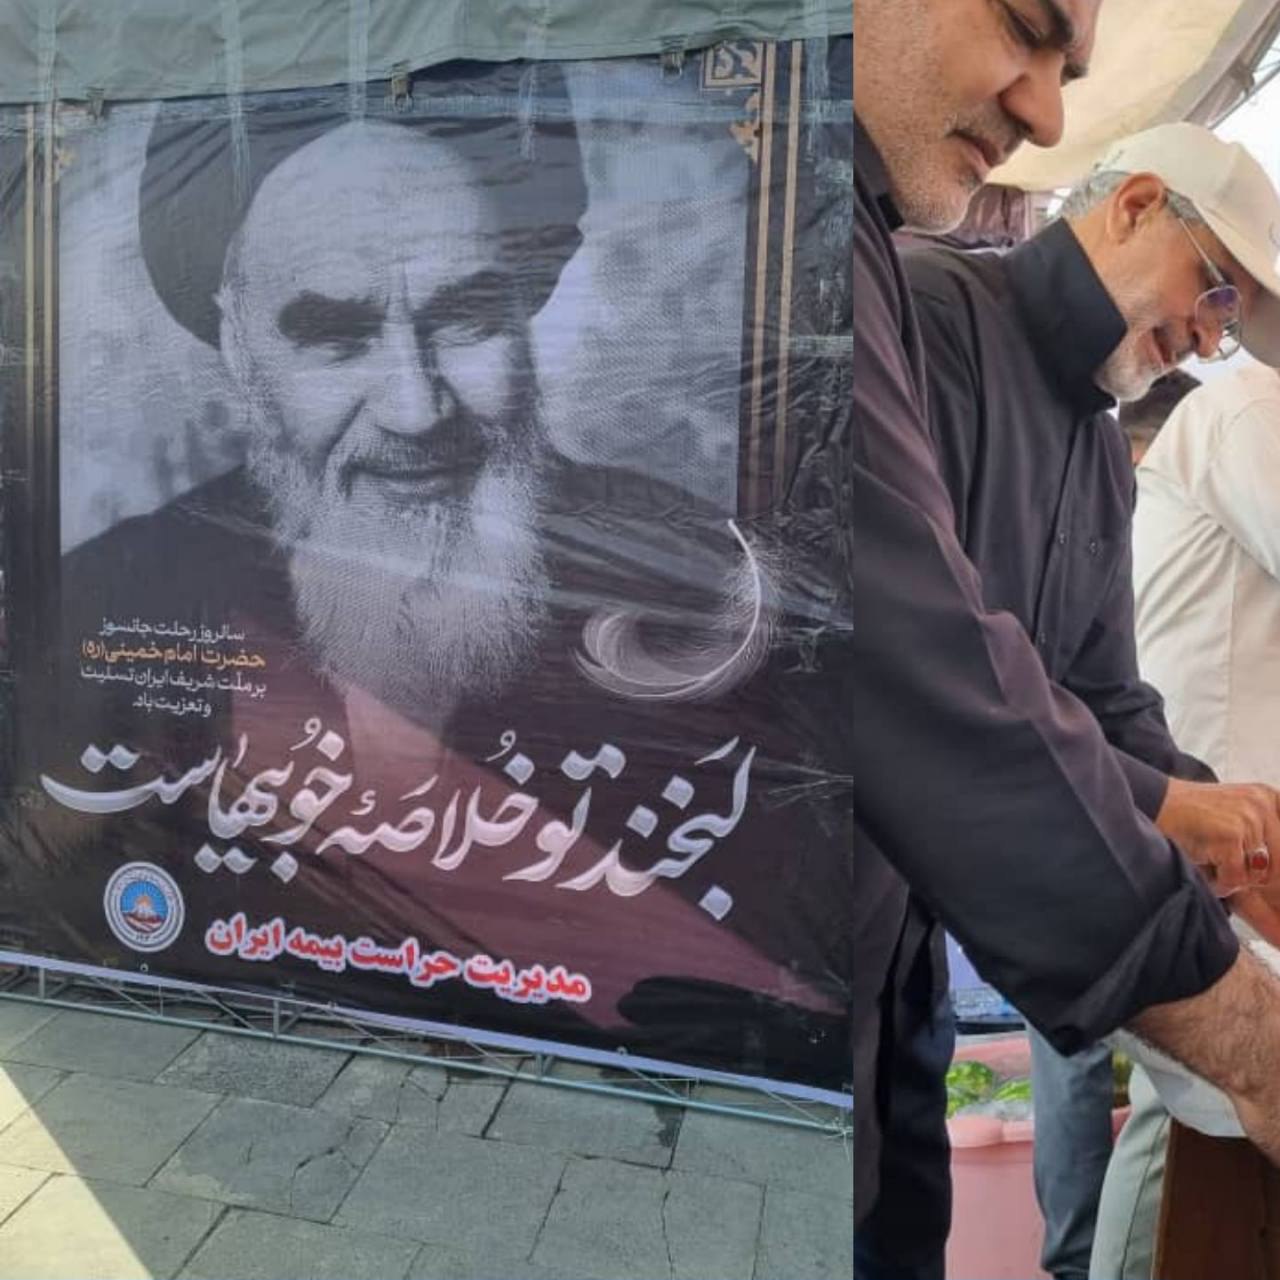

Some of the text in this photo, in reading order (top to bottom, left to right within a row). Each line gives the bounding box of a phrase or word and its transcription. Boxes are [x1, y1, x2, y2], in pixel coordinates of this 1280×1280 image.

[153, 620, 198, 642] رحلت
[105, 641, 162, 663] خمینی
[164, 643, 197, 664] امام
[201, 648, 267, 670] حضرت
[80, 664, 134, 682] تسلیت
[134, 666, 169, 687] ایران
[169, 670, 216, 692] شریف
[502, 744, 626, 882] تو
[205, 913, 591, 1003] مدیریت حراست بیمه ایران
